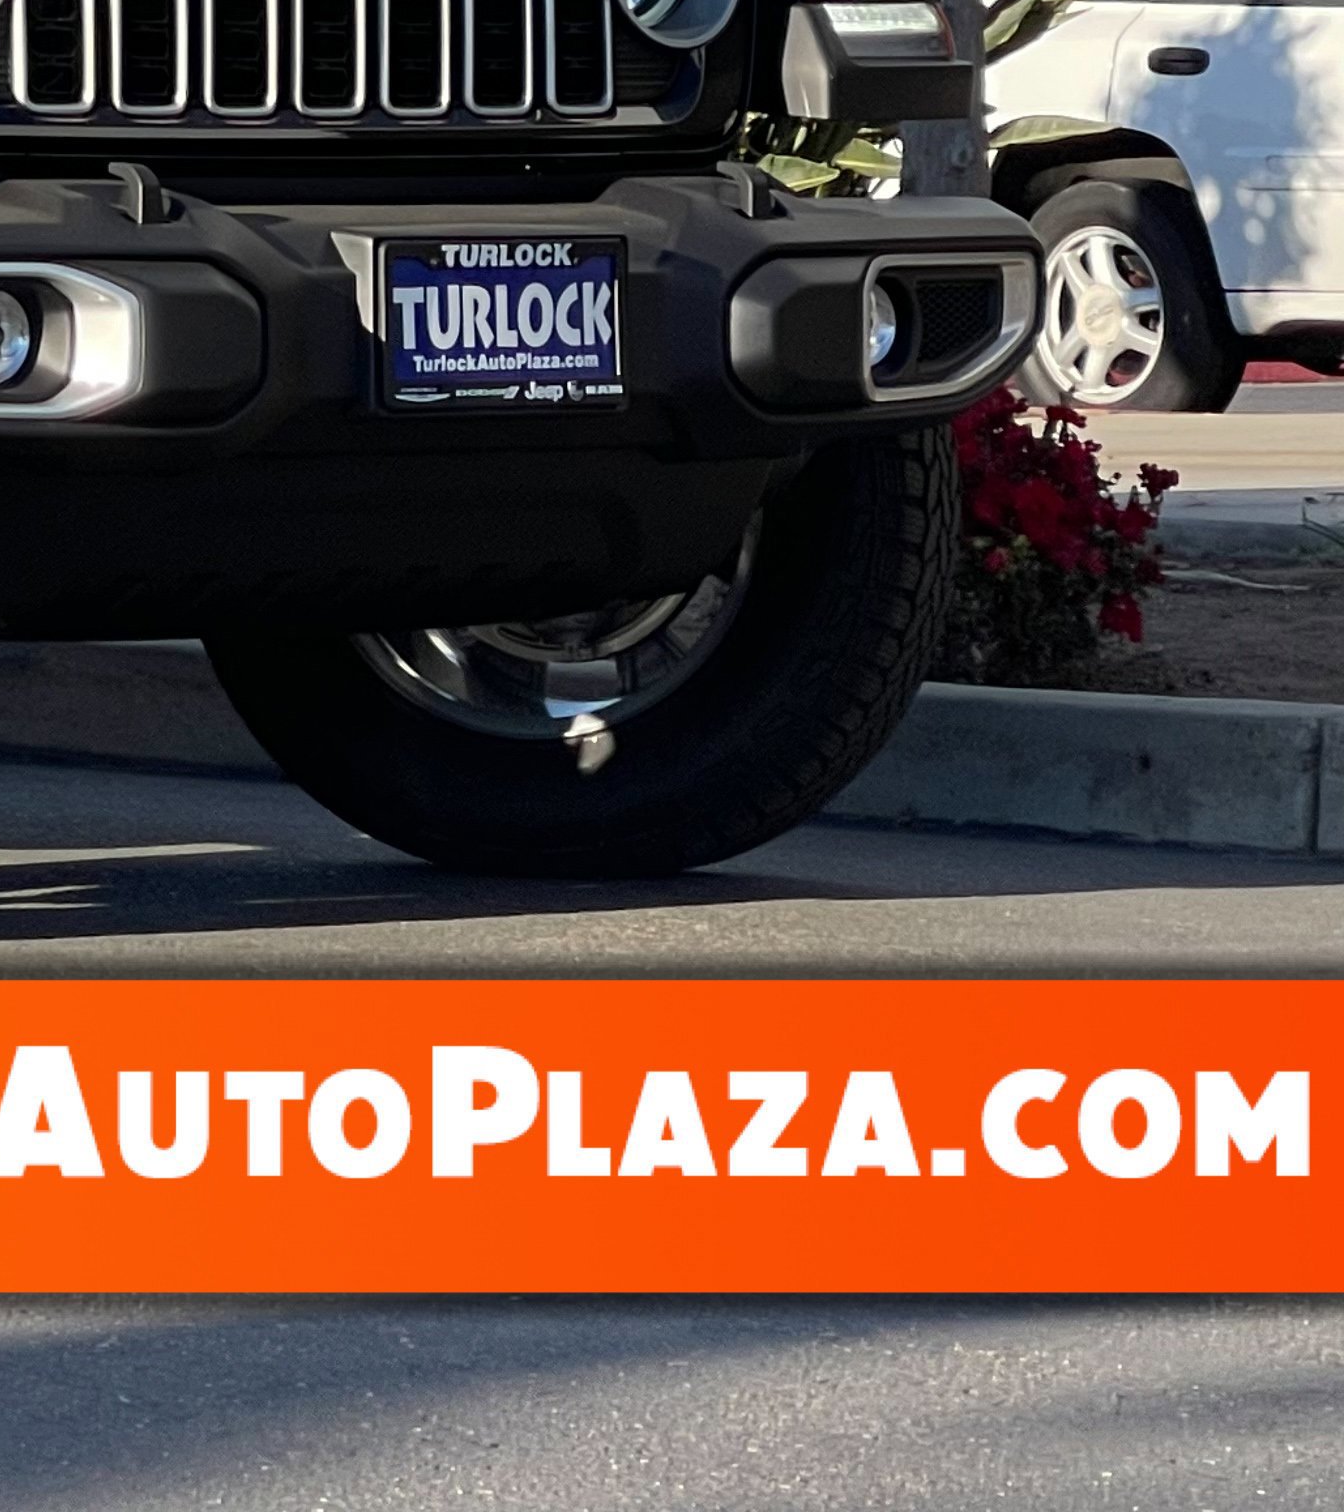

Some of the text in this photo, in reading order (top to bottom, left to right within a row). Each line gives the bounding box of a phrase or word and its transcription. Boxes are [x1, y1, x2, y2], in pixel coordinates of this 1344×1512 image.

[440, 242, 573, 268] TURLOCK
[392, 281, 612, 351] TURLOCK
[412, 352, 600, 374] TurlockAutoPlaza.com
[523, 380, 564, 403] Jeep
